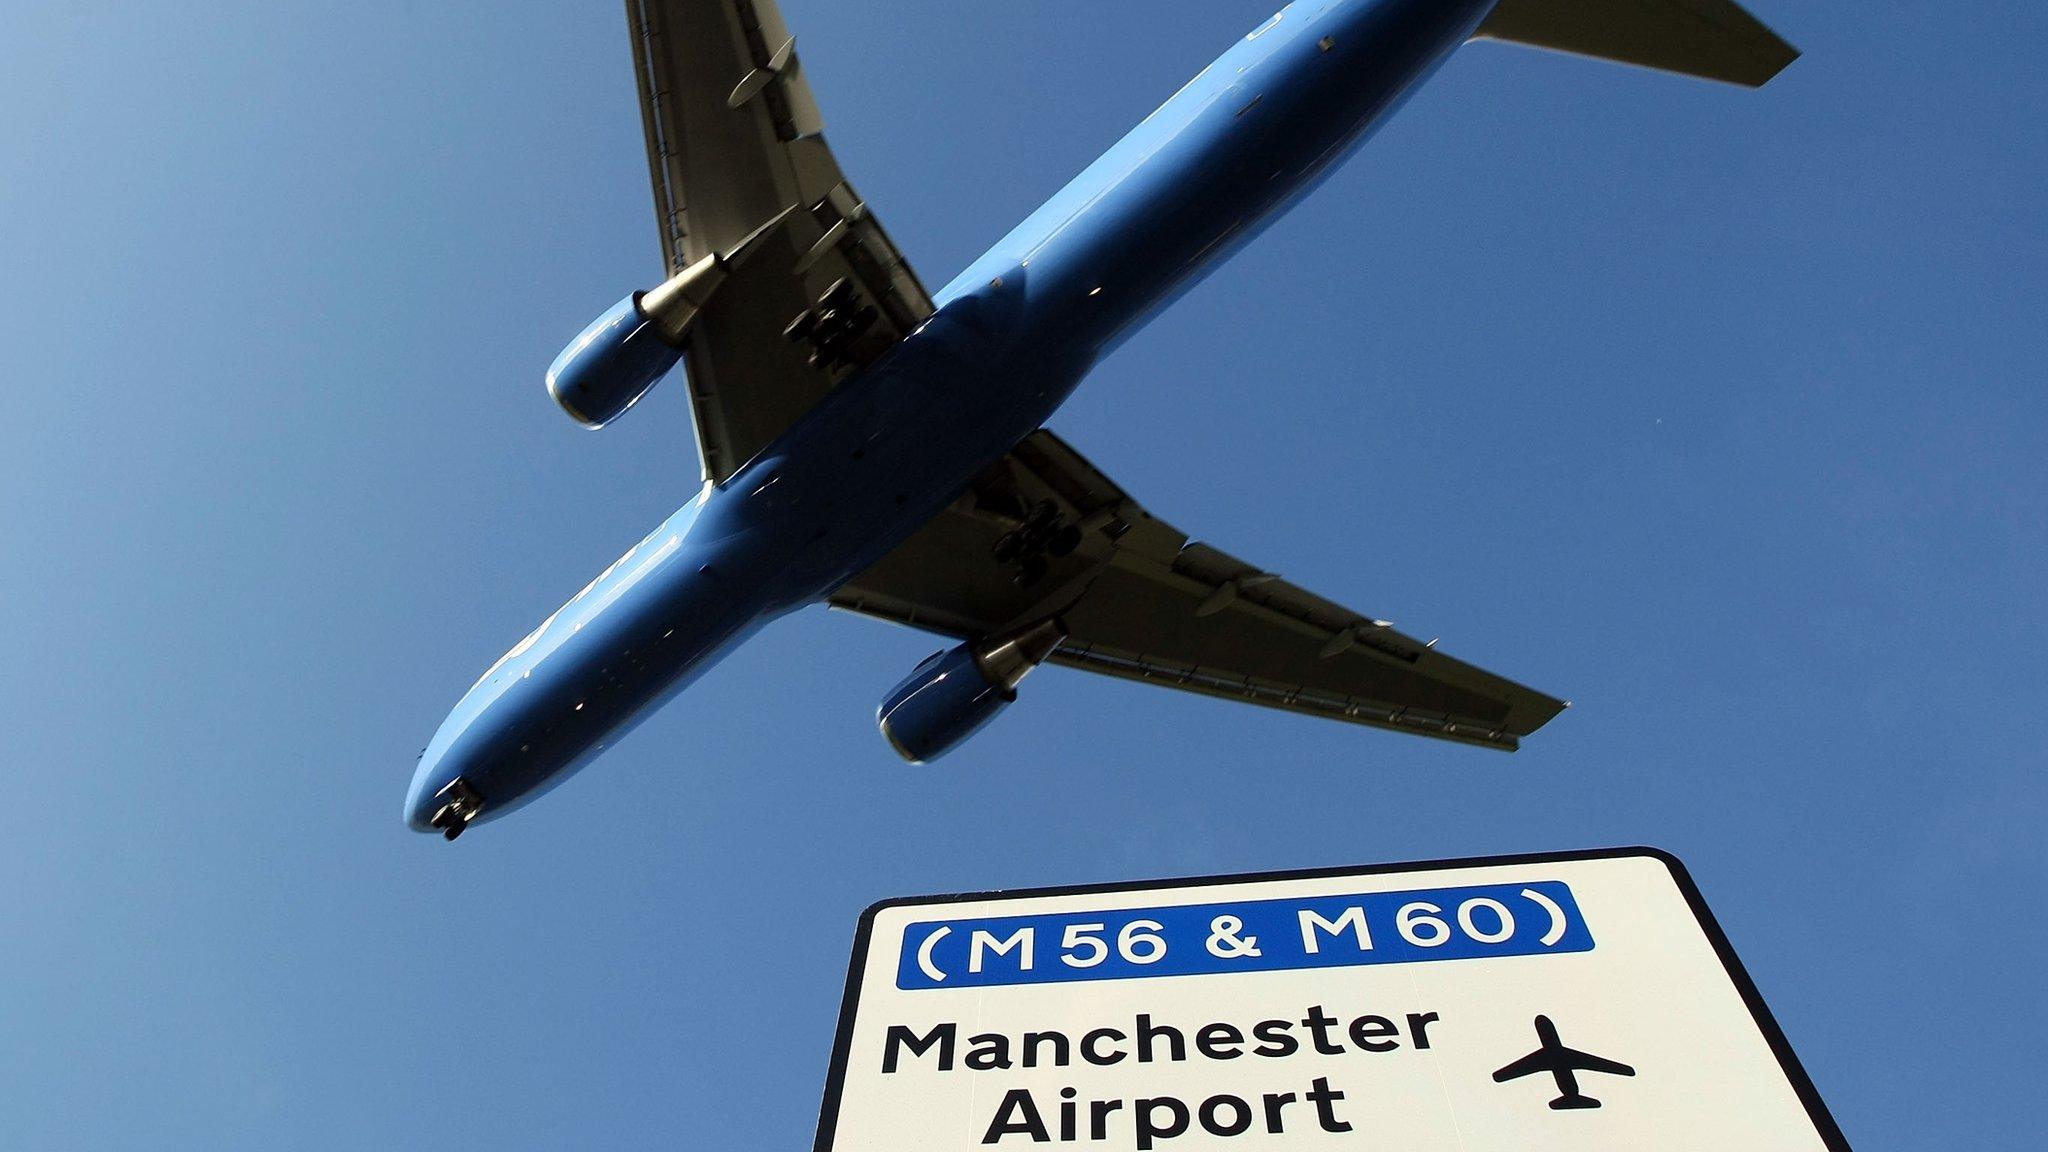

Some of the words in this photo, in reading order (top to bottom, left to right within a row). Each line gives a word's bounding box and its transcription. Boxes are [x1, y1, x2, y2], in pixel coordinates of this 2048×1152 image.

[1205, 914, 1263, 959] &
[881, 1004, 1441, 1074] Manchester
[981, 1076, 1354, 1151] Airport
